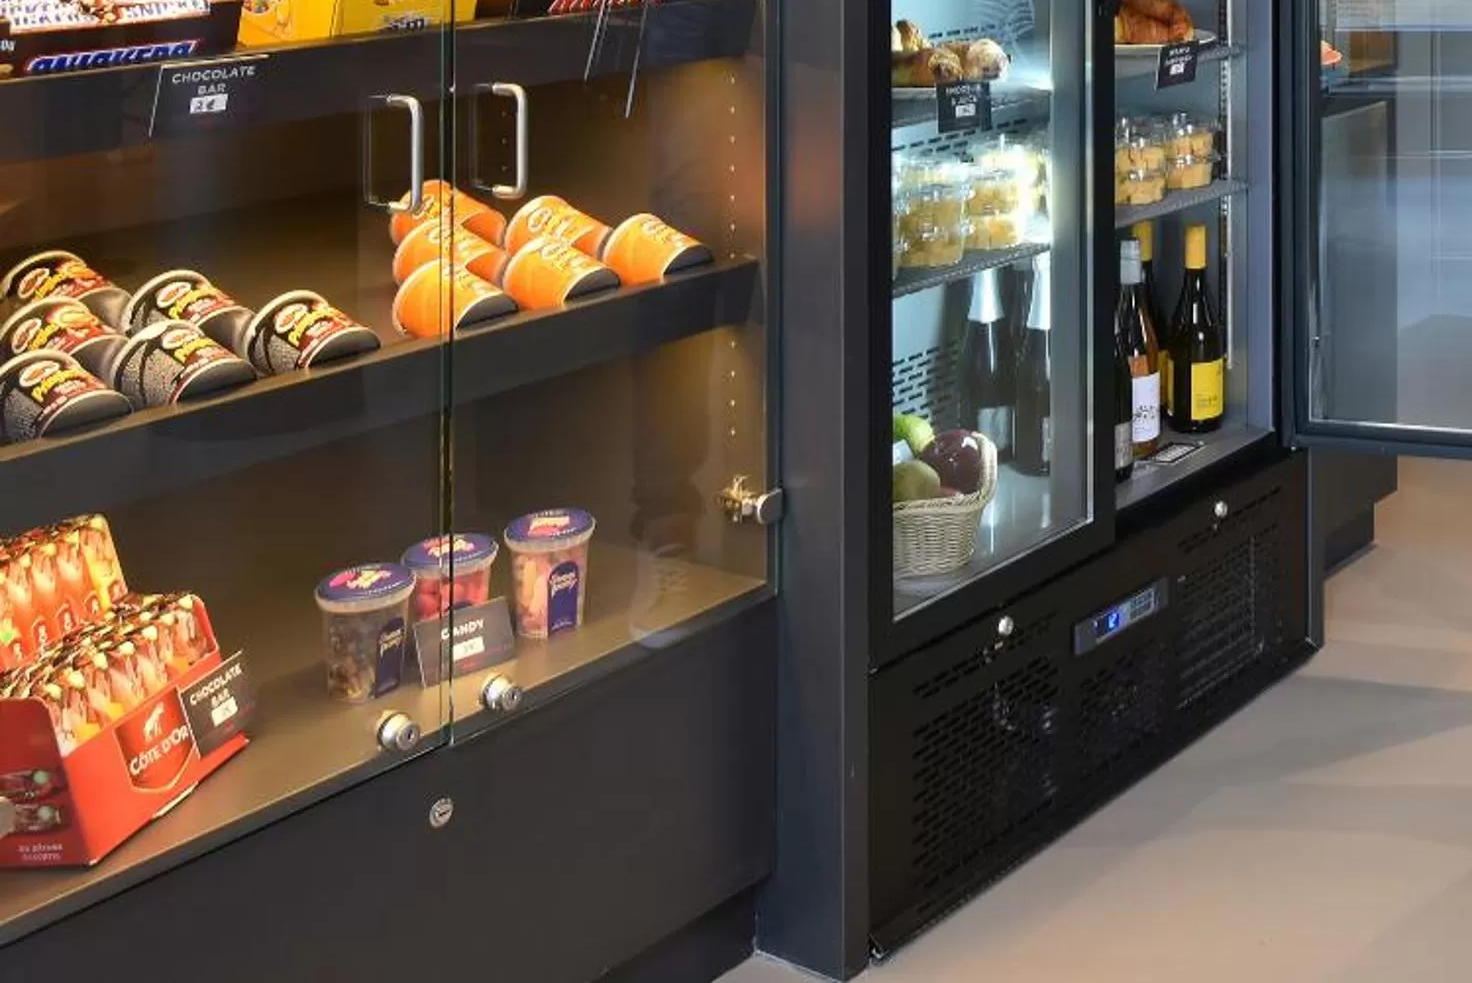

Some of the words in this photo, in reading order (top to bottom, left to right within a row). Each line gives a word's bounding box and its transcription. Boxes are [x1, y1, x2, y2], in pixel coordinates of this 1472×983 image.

[171, 65, 257, 85] CHOCOLATE
[198, 82, 227, 96] BAR
[189, 663, 242, 706] CHOCOLATE
